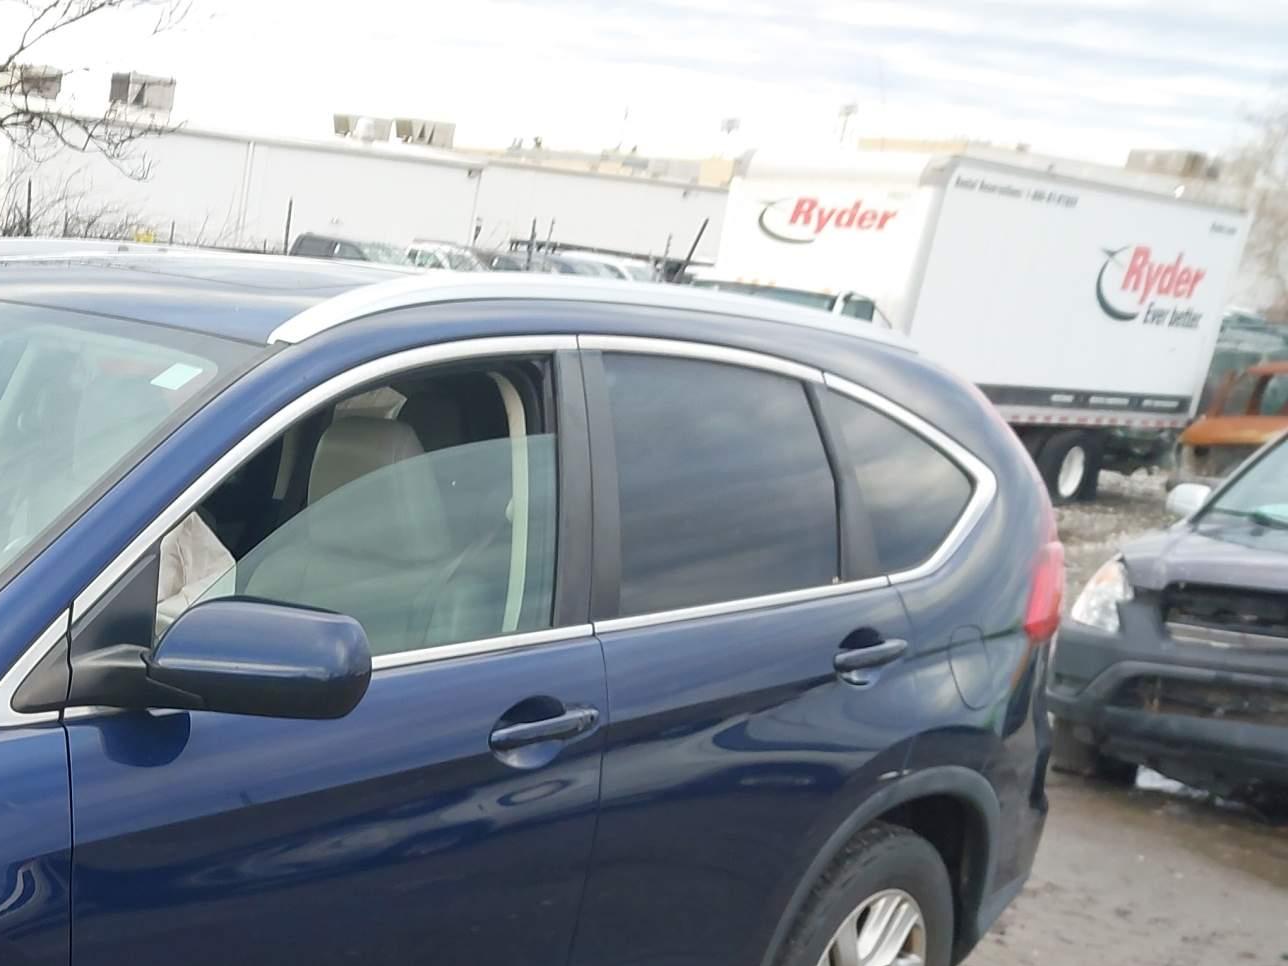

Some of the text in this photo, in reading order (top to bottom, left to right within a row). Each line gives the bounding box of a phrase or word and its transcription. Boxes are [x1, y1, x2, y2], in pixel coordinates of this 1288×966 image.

[789, 196, 897, 235] Ryder
[1120, 246, 1206, 304] Ryder
[1143, 301, 1203, 329] Ever better
